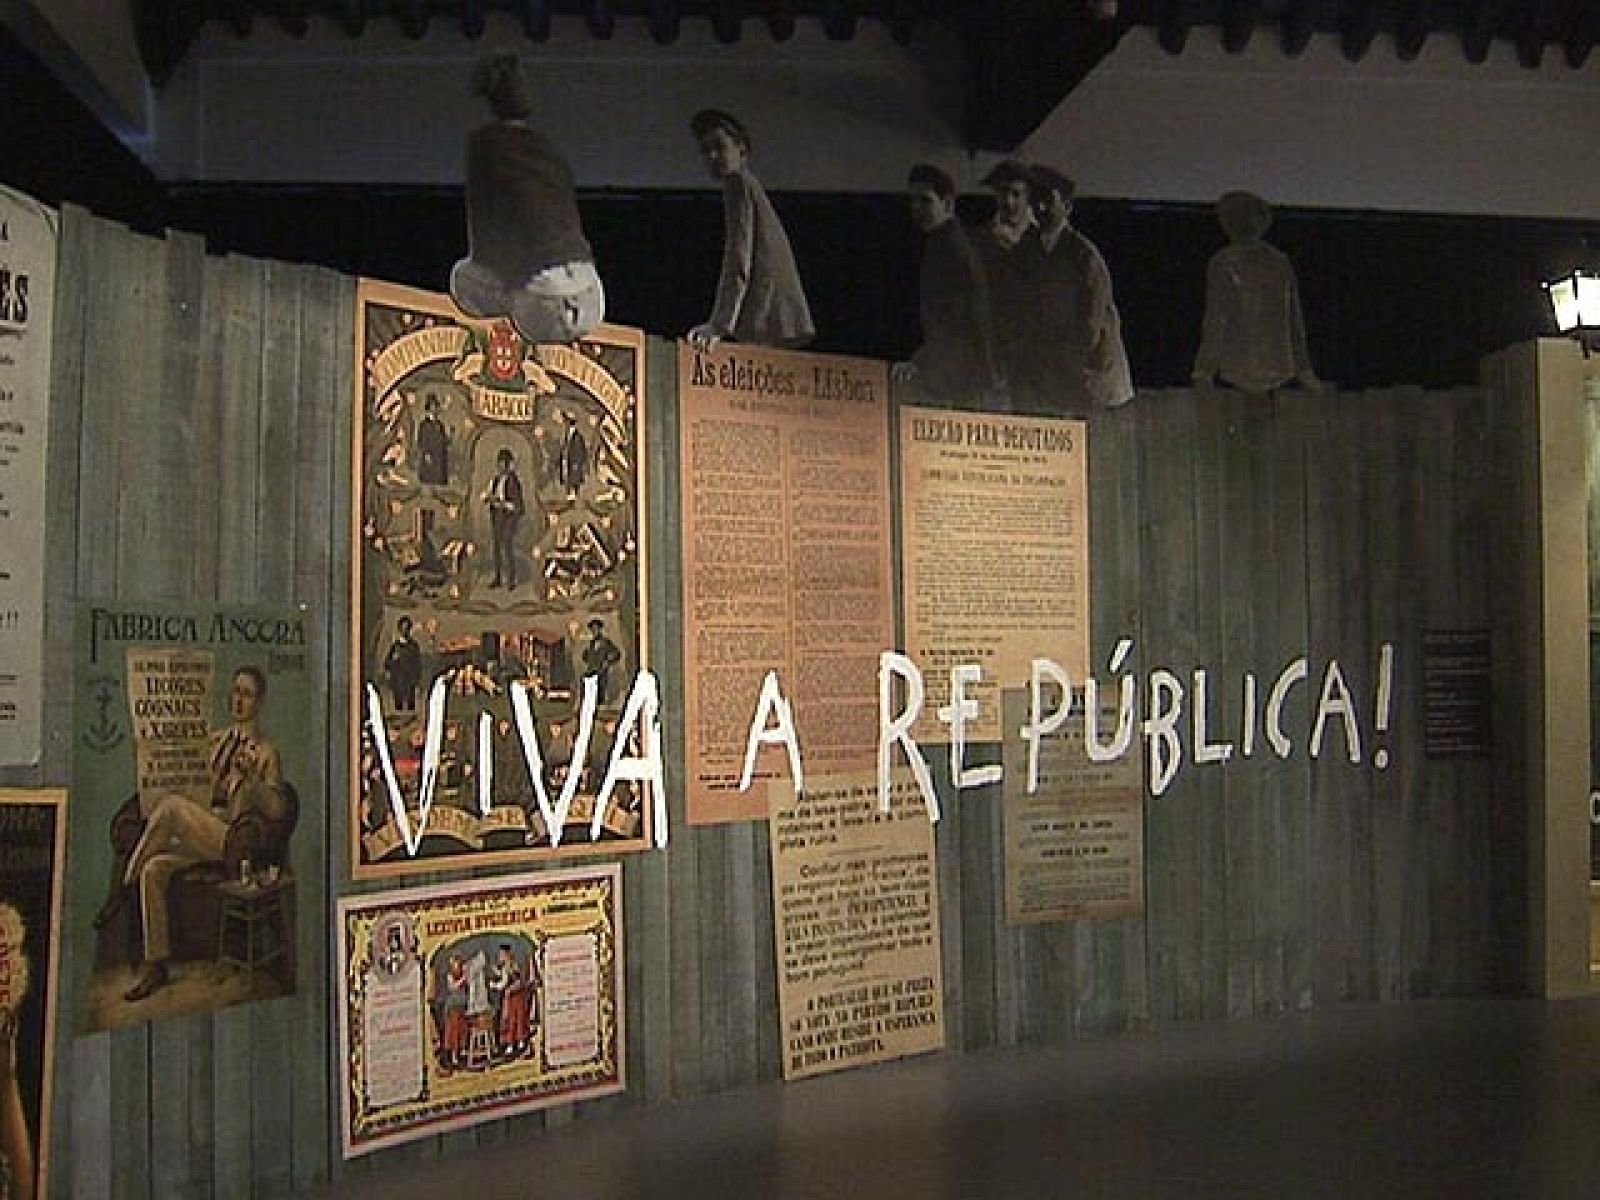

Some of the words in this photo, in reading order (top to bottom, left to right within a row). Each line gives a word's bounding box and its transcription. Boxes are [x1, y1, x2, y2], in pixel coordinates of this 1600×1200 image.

[691, 353, 716, 386] As
[719, 357, 795, 398] eleições
[814, 366, 876, 402] Lisboa
[967, 420, 1000, 448] PARA
[1004, 424, 1073, 453] DEPUTADOS
[89, 607, 197, 663] FABRICA
[208, 613, 305, 645] ANCORA
[367, 670, 668, 856] VIVA
[740, 669, 804, 792] A
